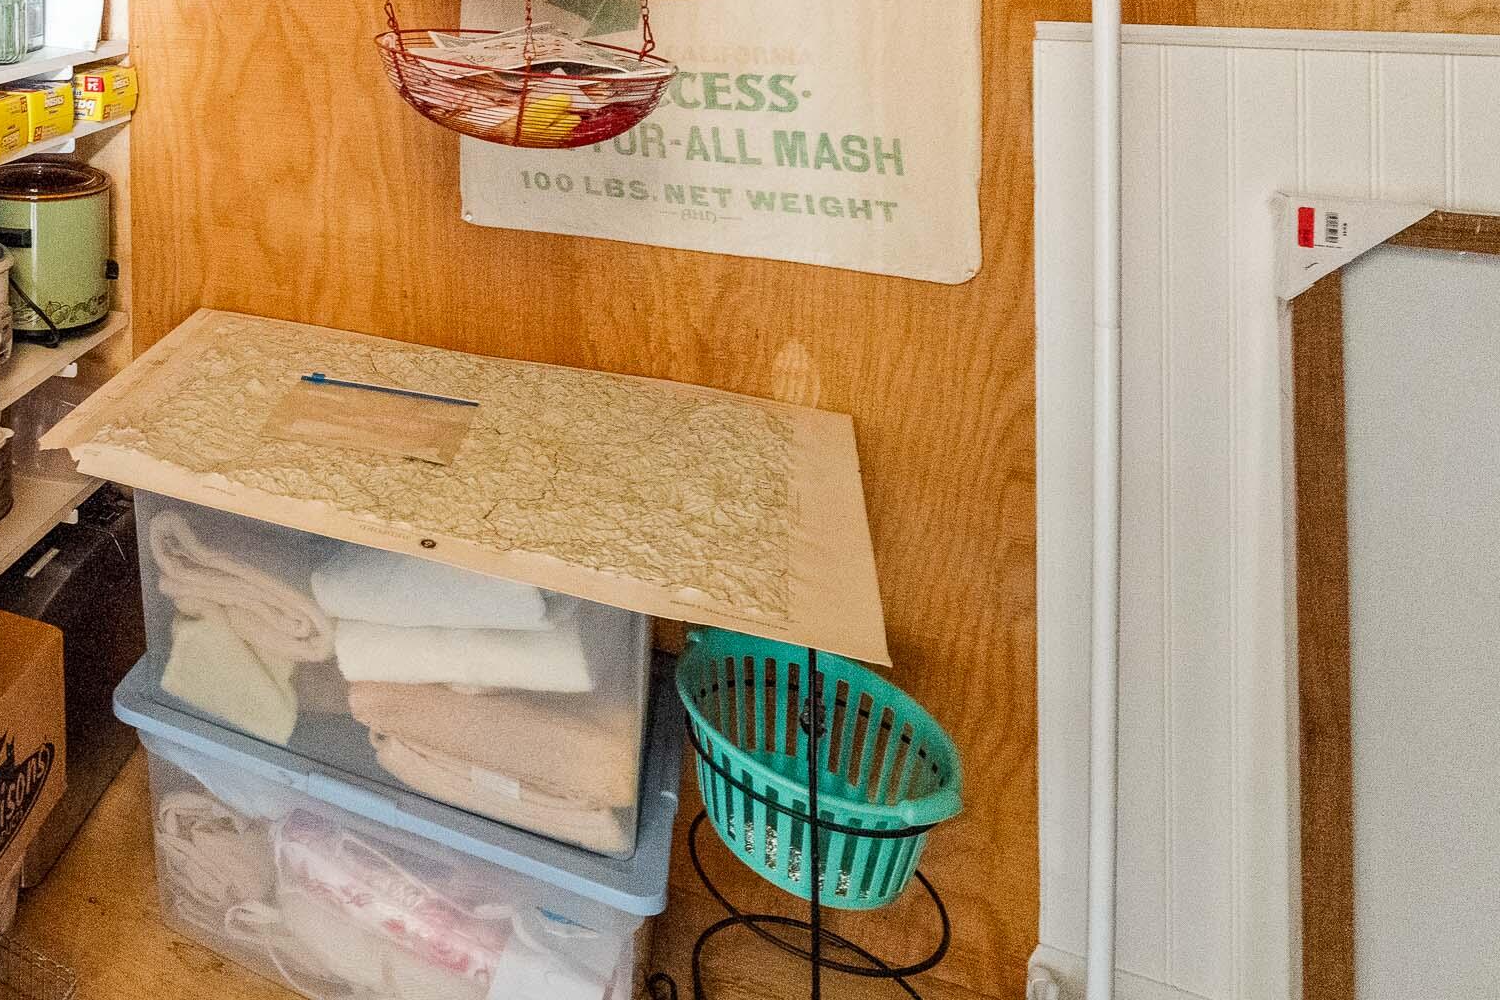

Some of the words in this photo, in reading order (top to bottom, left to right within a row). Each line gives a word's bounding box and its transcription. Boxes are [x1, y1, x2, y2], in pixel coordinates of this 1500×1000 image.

[773, 129, 906, 177] MASH
[520, 170, 573, 193] 100
[663, 183, 733, 203] NET
[745, 190, 900, 223] WEIGHT
